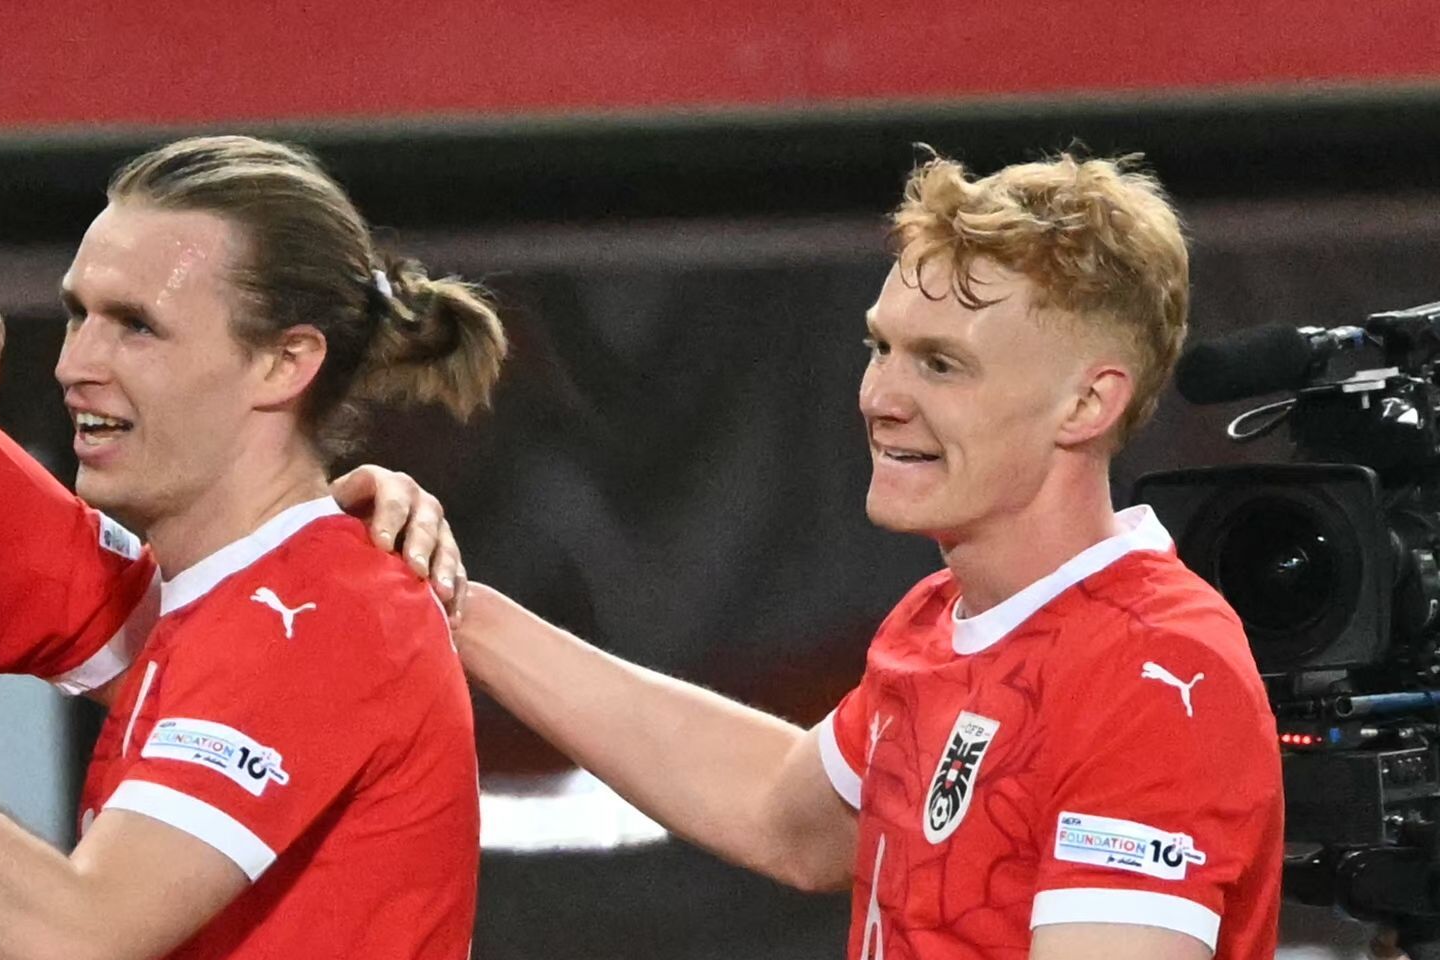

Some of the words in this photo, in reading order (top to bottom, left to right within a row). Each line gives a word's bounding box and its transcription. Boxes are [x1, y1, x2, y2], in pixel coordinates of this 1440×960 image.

[237, 747, 267, 779] 10
[1060, 830, 1146, 854] FOUNDATION
[1150, 839, 1183, 868] 10
